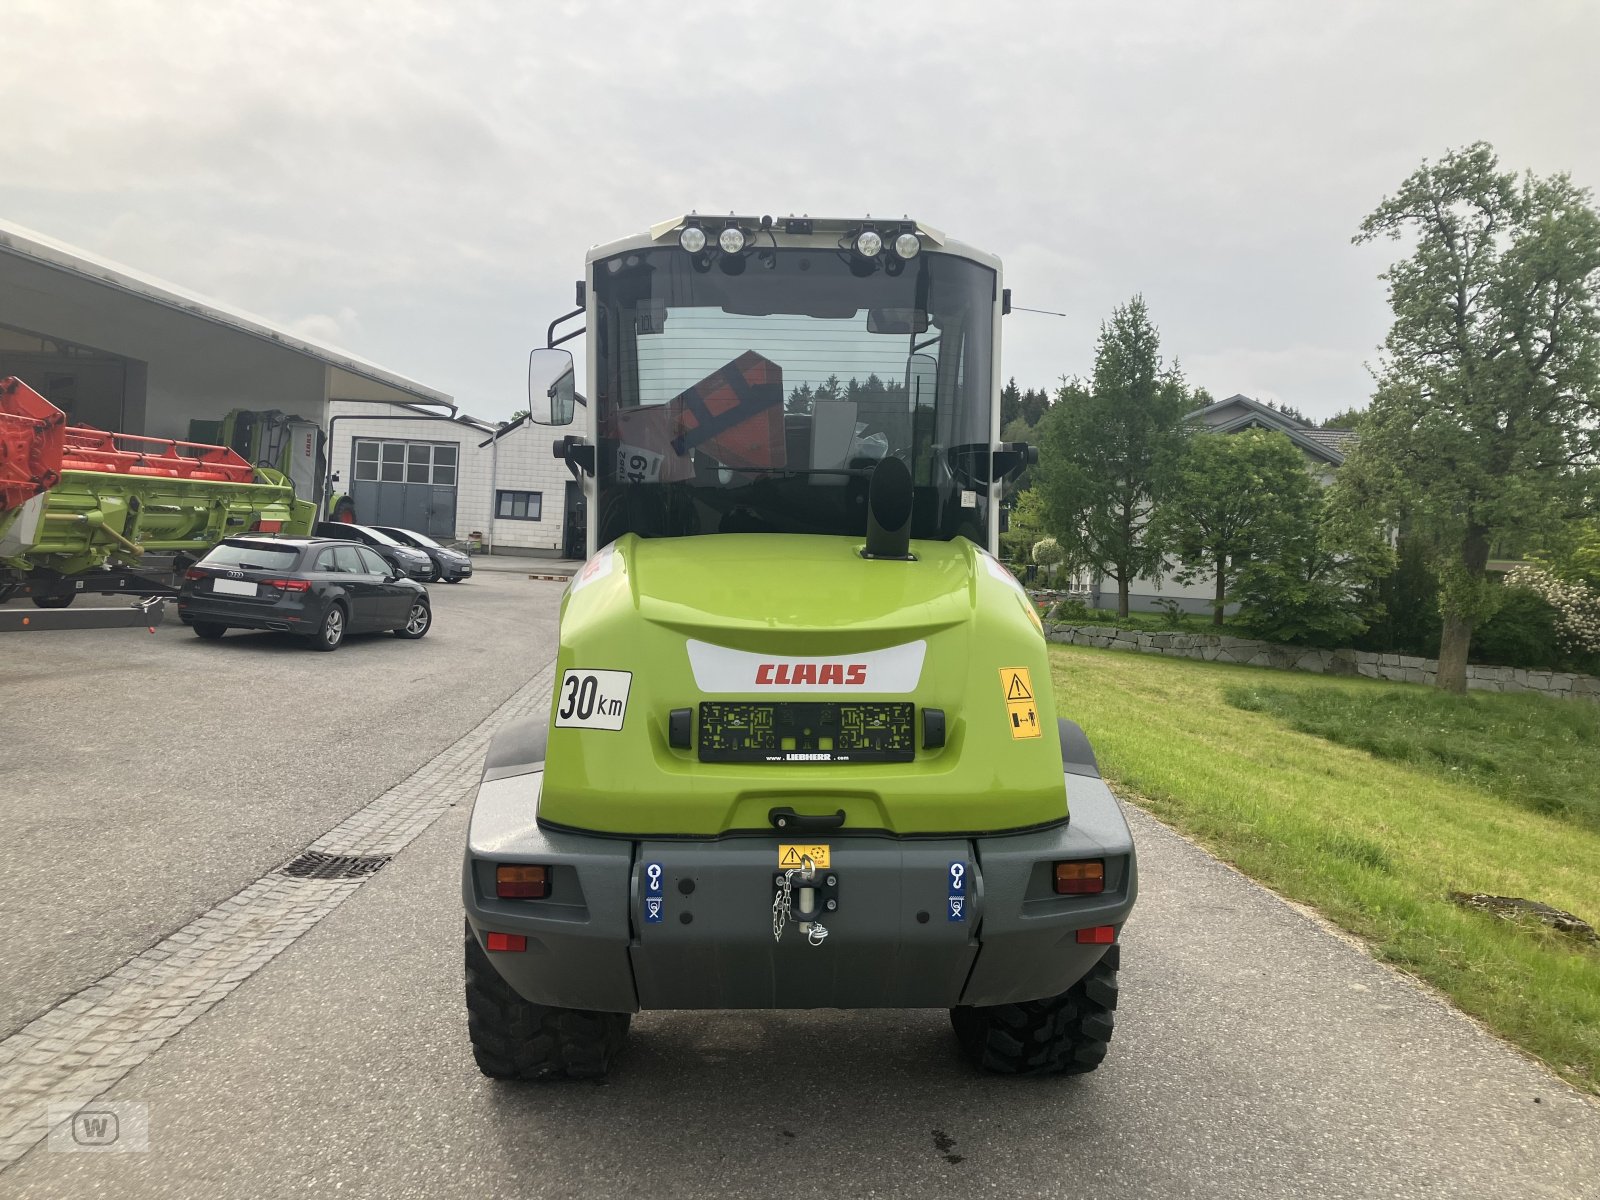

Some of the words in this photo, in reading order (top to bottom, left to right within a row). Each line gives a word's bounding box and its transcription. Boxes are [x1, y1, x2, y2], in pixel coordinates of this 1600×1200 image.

[755, 664, 867, 684] CLAAS
[560, 675, 598, 720] 30
[597, 695, 623, 717] km
